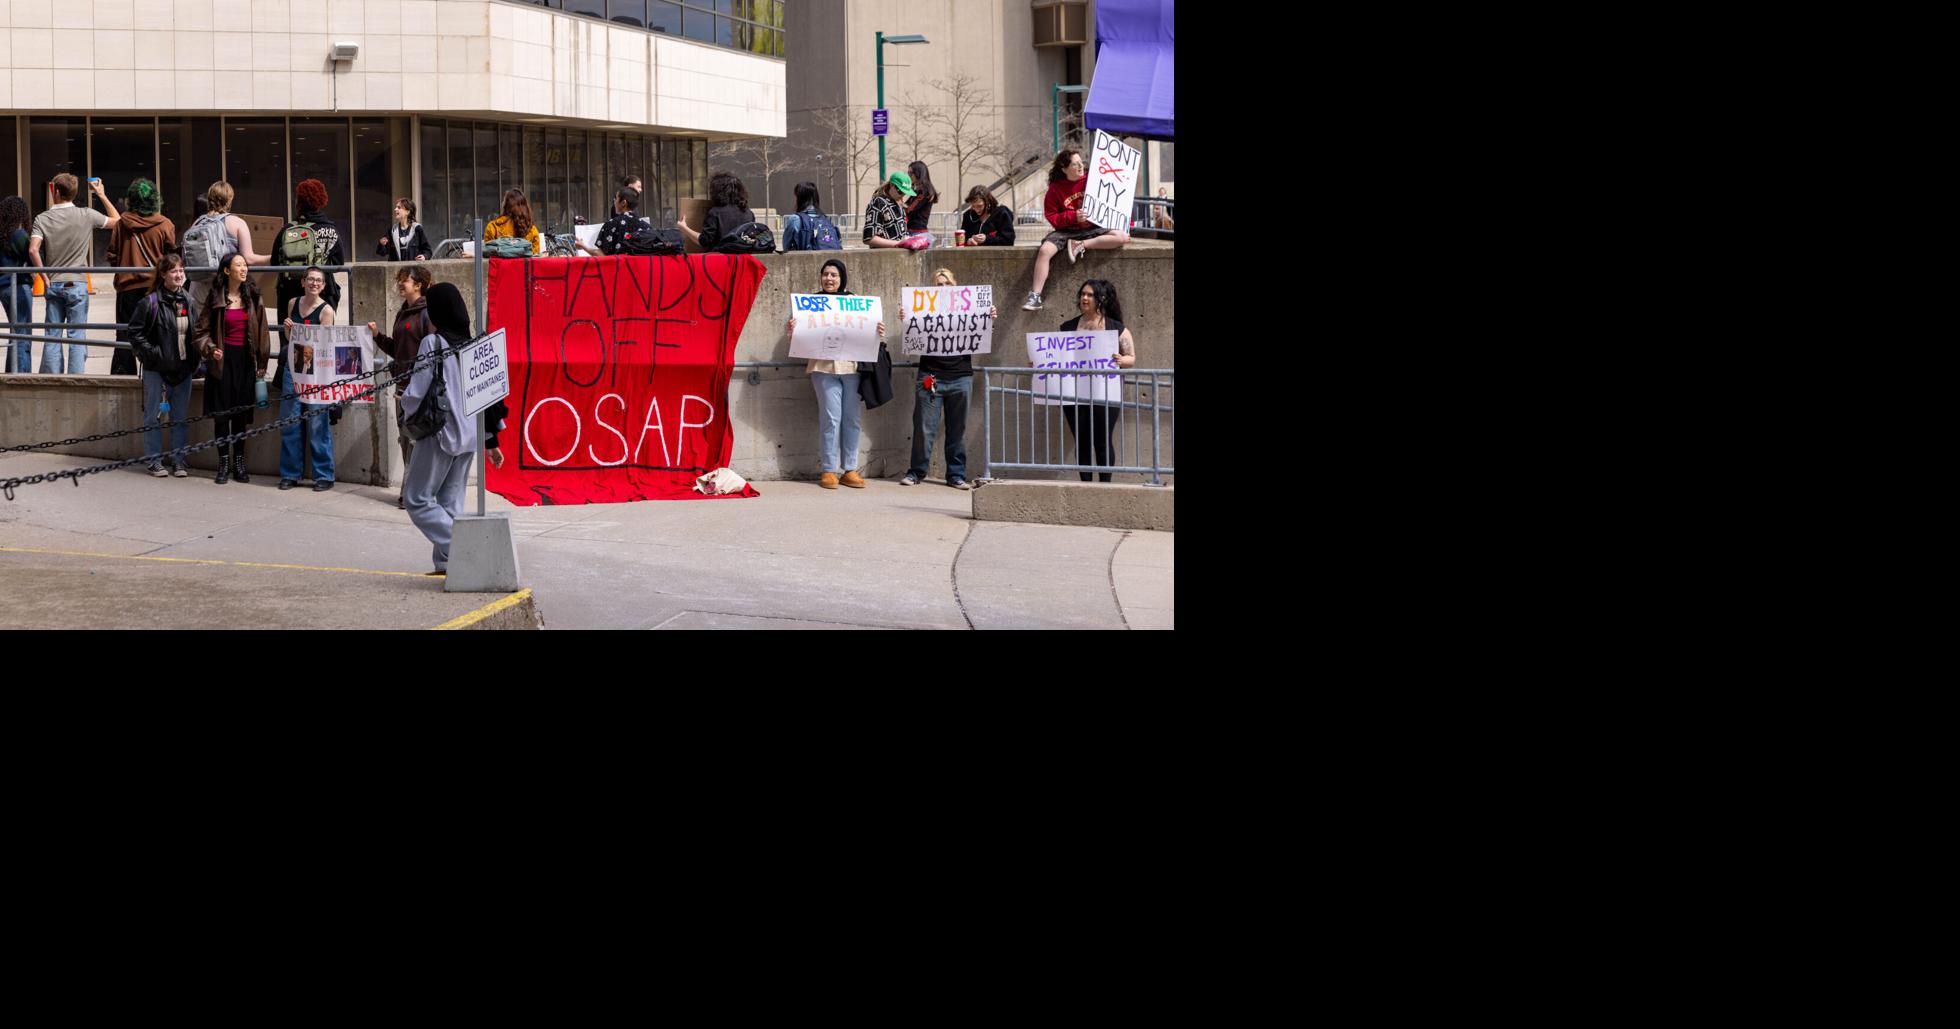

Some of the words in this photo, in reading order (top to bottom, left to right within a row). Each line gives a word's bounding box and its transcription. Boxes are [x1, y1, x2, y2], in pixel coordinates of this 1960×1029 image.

[1096, 132, 1140, 170] DONT
[1097, 179, 1126, 207] MY
[531, 254, 729, 320] HANDS
[795, 296, 832, 312] LOSER
[836, 297, 874, 312] THIEF
[912, 287, 971, 313] DYES
[291, 324, 321, 342] SPOT
[325, 326, 358, 342] THE
[808, 313, 868, 329] ALERT
[906, 311, 991, 334] AGAINST
[473, 341, 494, 363] AREA
[561, 318, 697, 388] OFF
[926, 333, 982, 354] DOUG
[1034, 336, 1096, 352] INVEST
[469, 354, 500, 381] CLOSED
[1037, 358, 1117, 380] STUDENTS
[466, 386, 476, 399] NOT
[476, 371, 505, 393] MAINTAINED
[524, 393, 715, 467] OSAP
